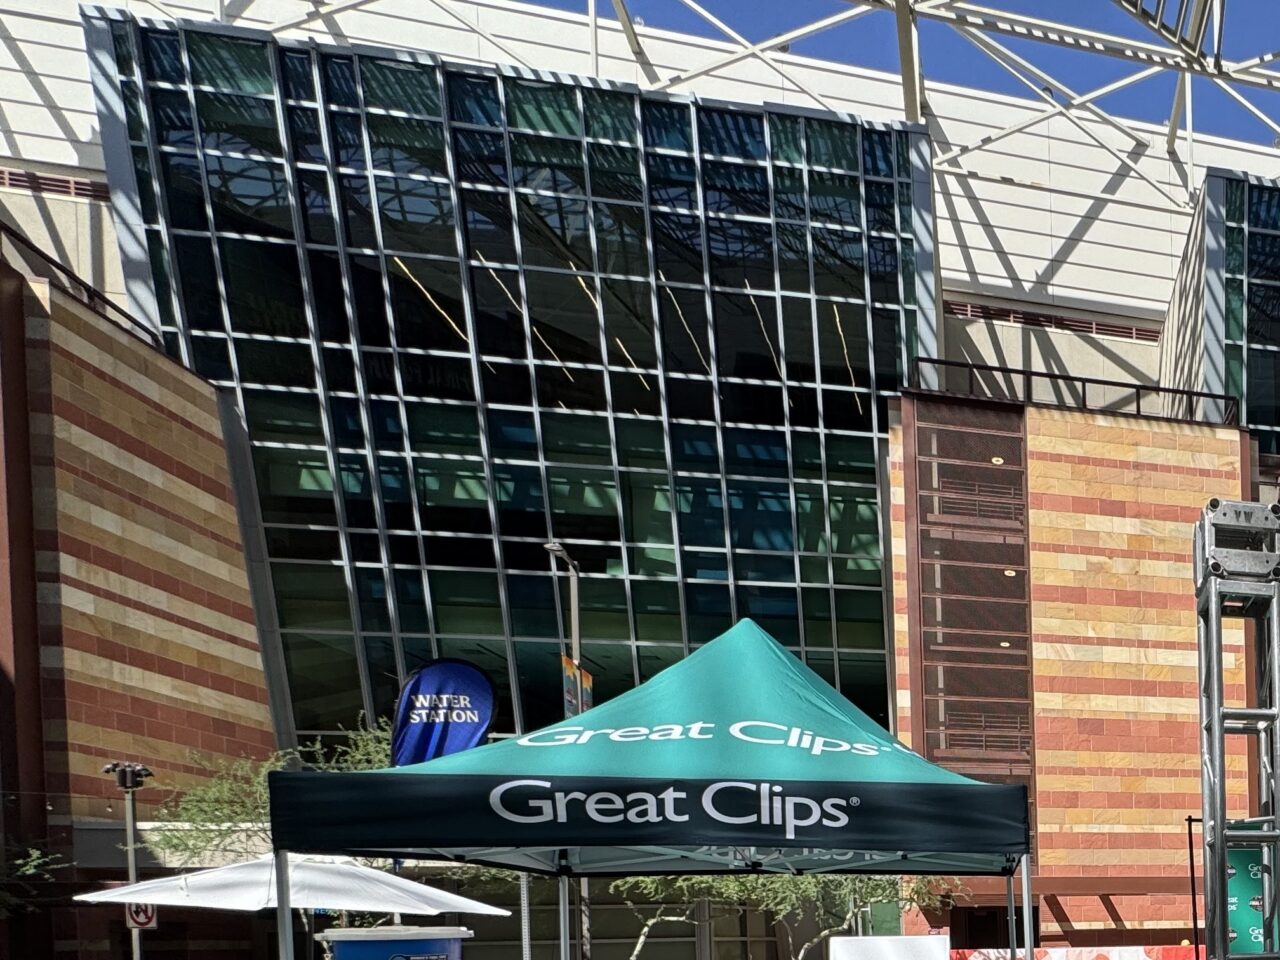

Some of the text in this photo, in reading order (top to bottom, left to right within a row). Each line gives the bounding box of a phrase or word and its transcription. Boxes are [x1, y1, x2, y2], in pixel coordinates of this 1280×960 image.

[411, 694, 472, 708] WATER
[409, 709, 480, 724] STATION
[516, 721, 715, 747] Great
[489, 779, 690, 823] Great
